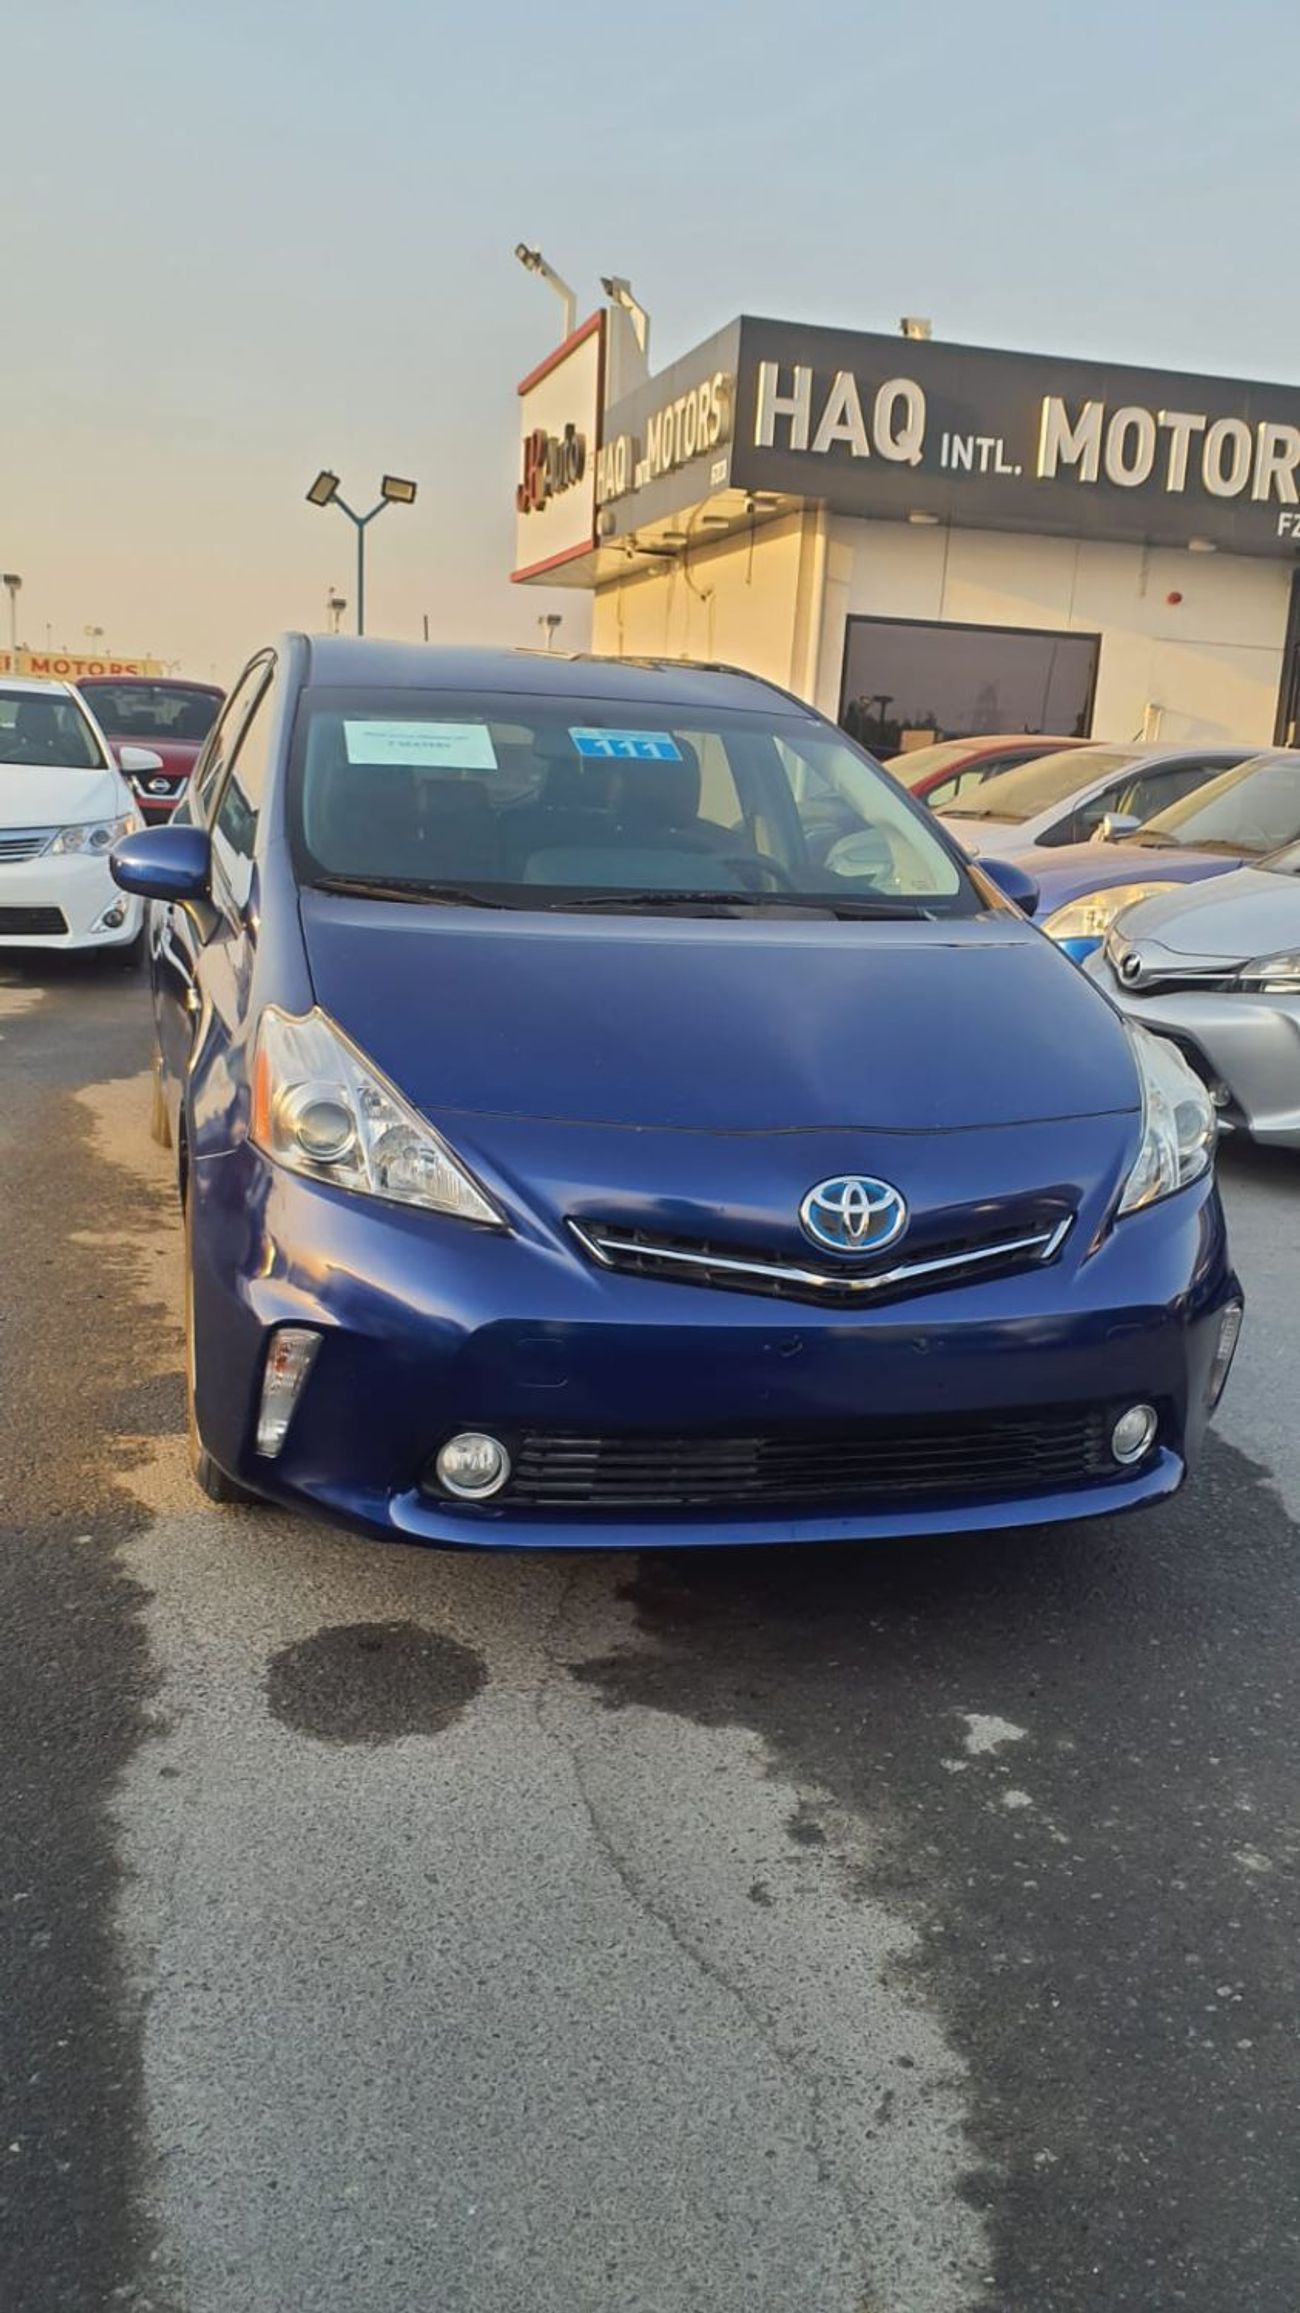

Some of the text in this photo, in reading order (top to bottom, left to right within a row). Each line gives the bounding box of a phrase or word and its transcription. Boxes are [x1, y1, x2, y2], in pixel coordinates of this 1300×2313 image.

[597, 371, 724, 506] HAQ MOTORS
[755, 361, 1300, 504] HAQ INTL. MOTOR
[31, 657, 138, 677] MOTORS
[594, 739, 662, 757] 111
